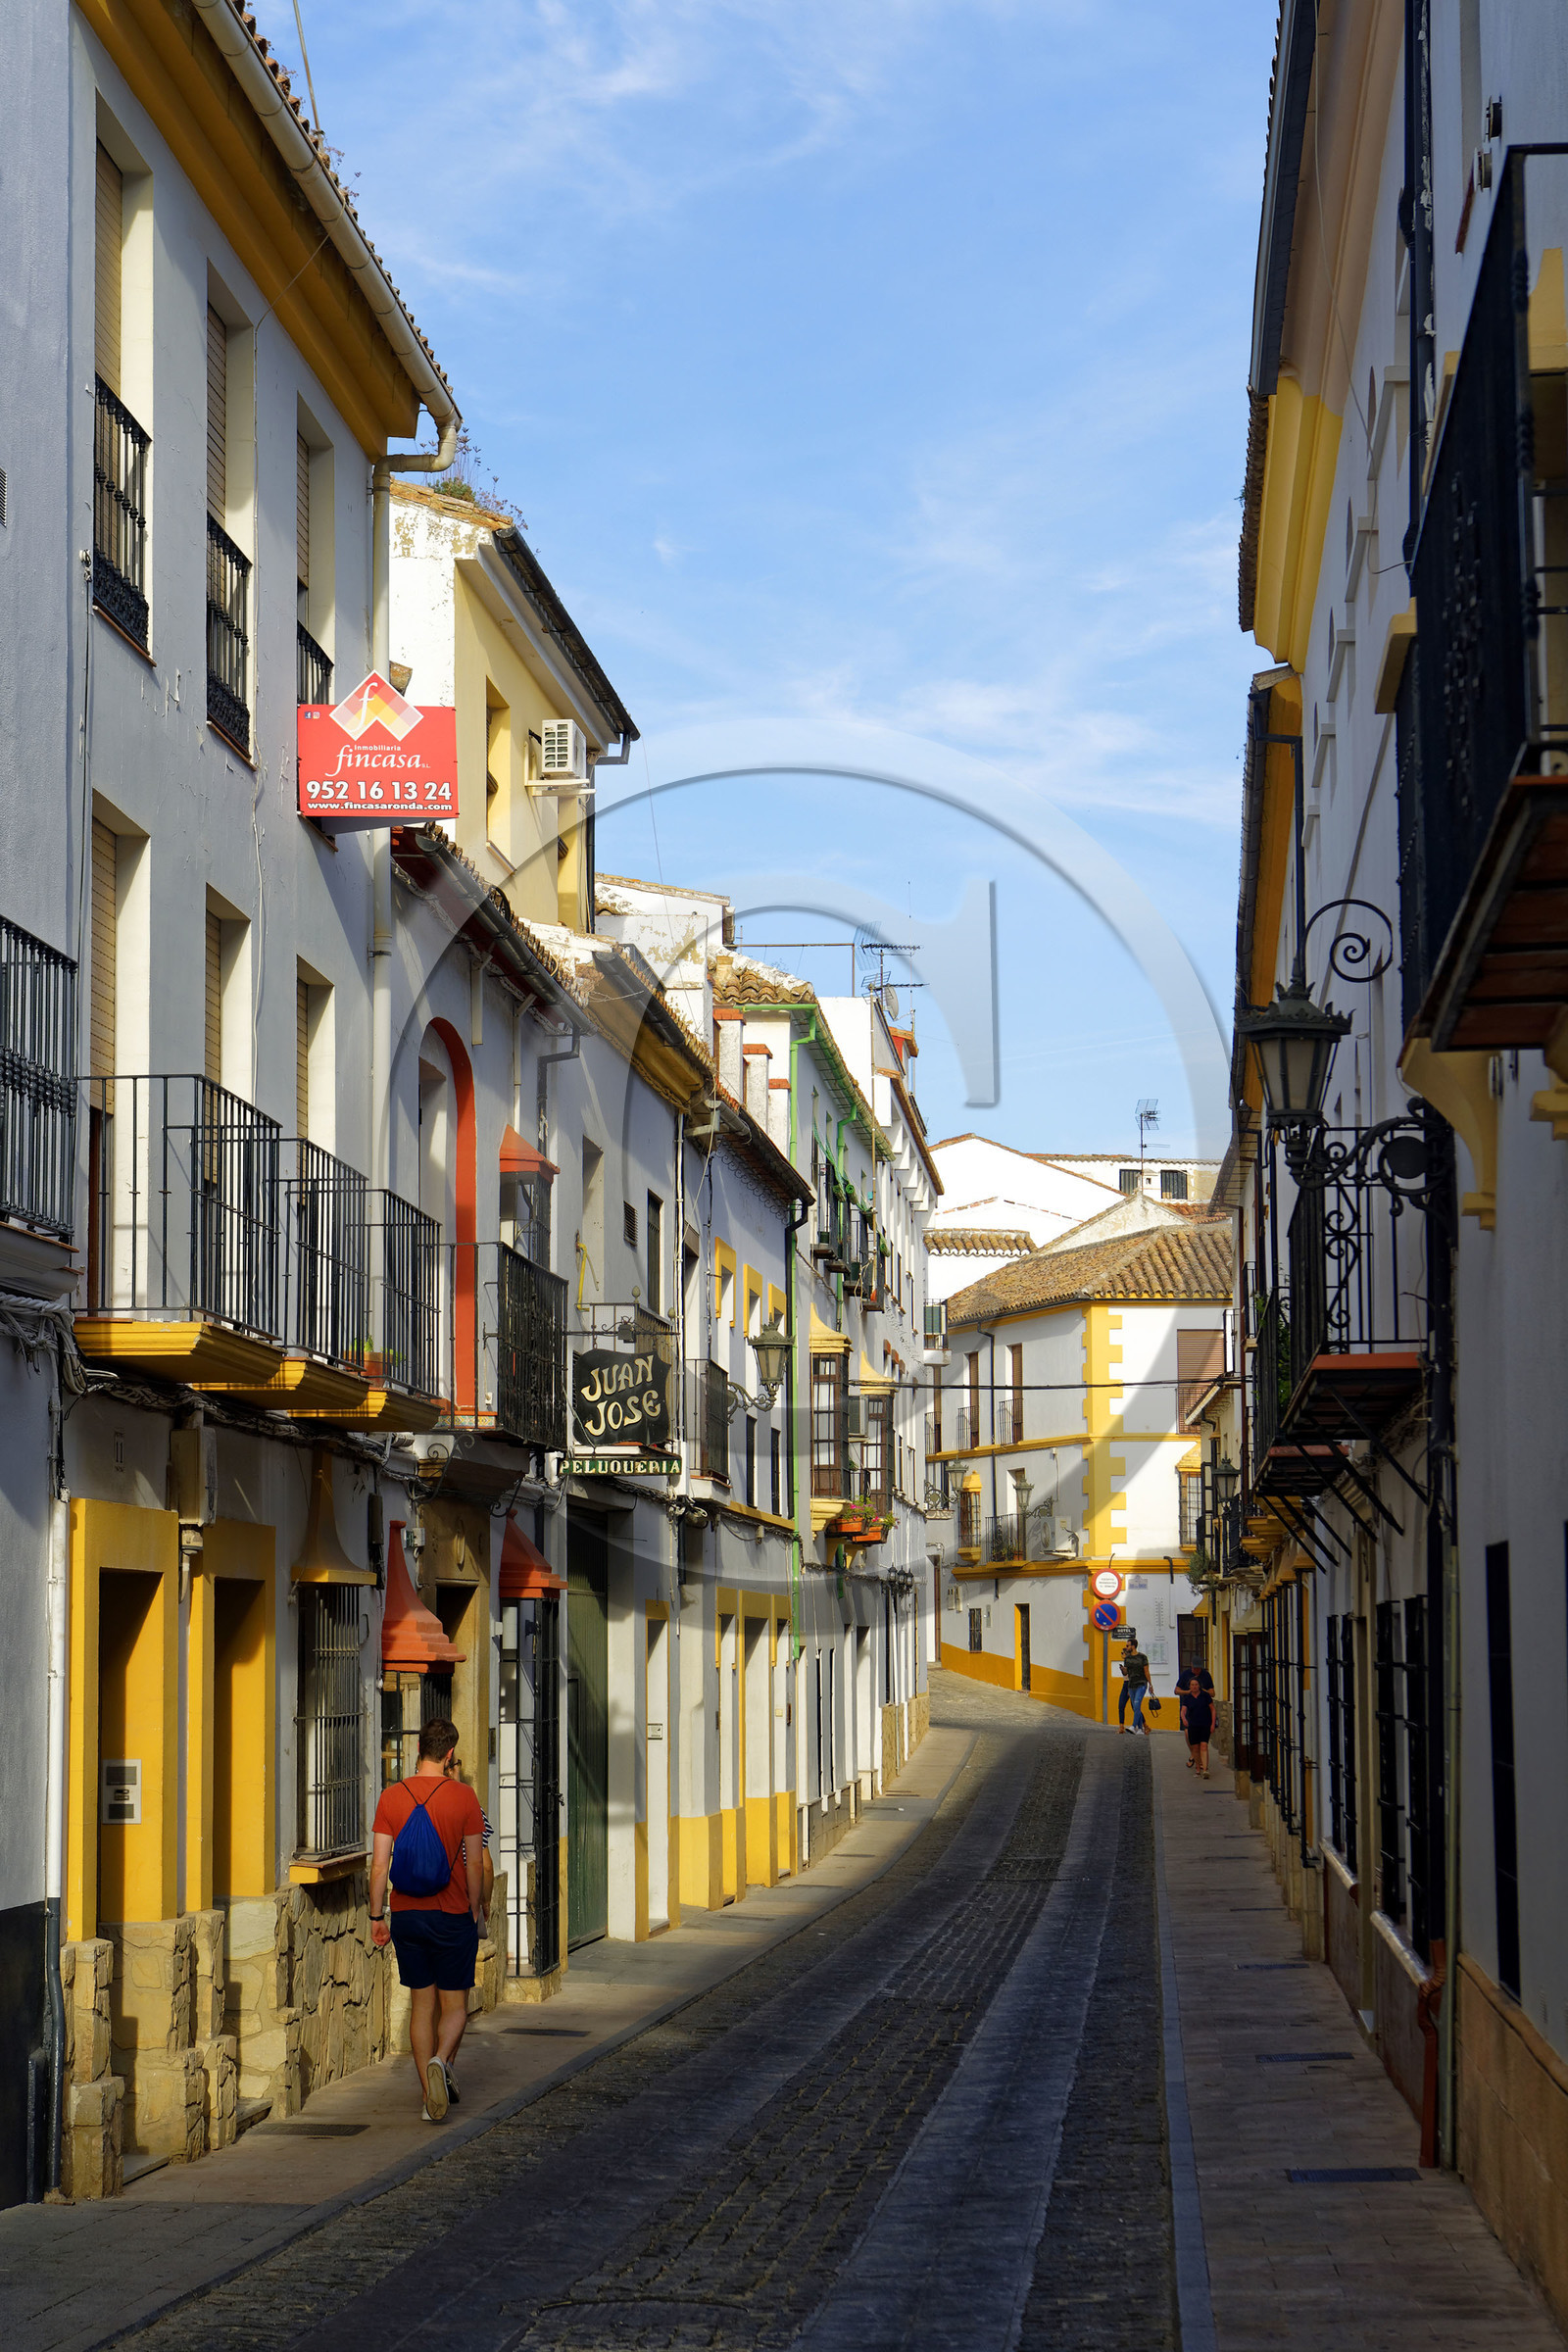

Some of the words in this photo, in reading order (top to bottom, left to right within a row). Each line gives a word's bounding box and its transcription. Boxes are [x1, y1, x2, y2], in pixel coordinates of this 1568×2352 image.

[324, 744, 421, 777] fincasa
[306, 780, 349, 801] 952
[357, 781, 384, 801] 16
[391, 781, 418, 801] 13
[424, 781, 453, 802] 24
[307, 802, 453, 810] www.fincasaronda.com
[580, 1354, 655, 1402] JUAN
[584, 1390, 661, 1437] JOSE
[560, 1459, 681, 1475] PELUQUERIA
